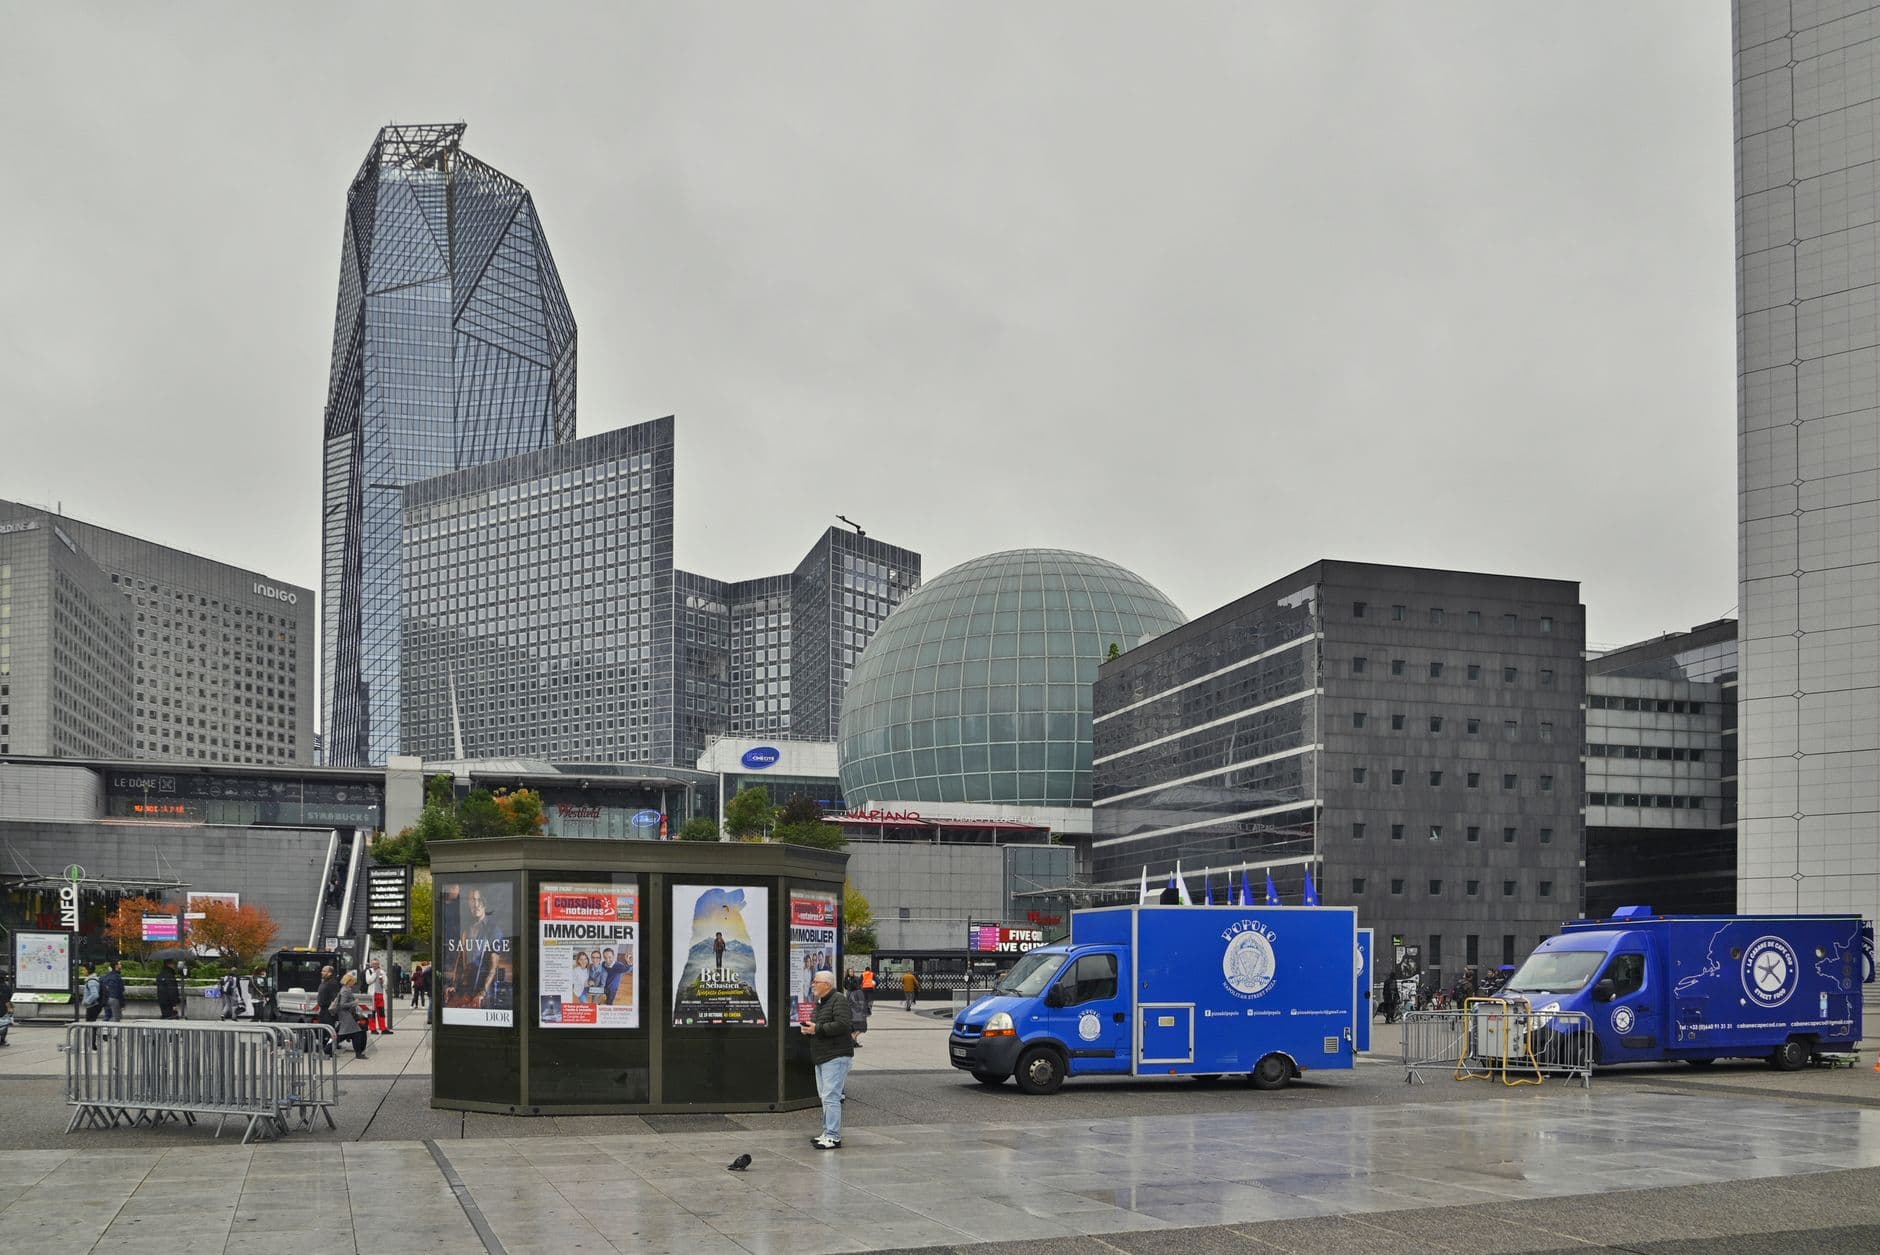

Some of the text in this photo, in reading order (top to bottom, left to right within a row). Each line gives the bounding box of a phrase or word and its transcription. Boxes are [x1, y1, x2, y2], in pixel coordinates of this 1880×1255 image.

[253, 583, 297, 605] INDIGO
[114, 779, 126, 787] LE
[306, 811, 370, 822] STARBUCKS
[558, 803, 601, 818] Westfield
[61, 887, 74, 927] INFO
[565, 906, 604, 915] notaires
[543, 924, 634, 940] IMMOBILIER
[1009, 930, 1031, 941] FIVE
[1221, 919, 1277, 943] POPOLO
[448, 939, 510, 952] SAUVAGE
[999, 943, 1018, 952] IVE
[701, 967, 739, 982] Belle
[1247, 989, 1266, 1000] STREET
[485, 1012, 510, 1022] DIOR
